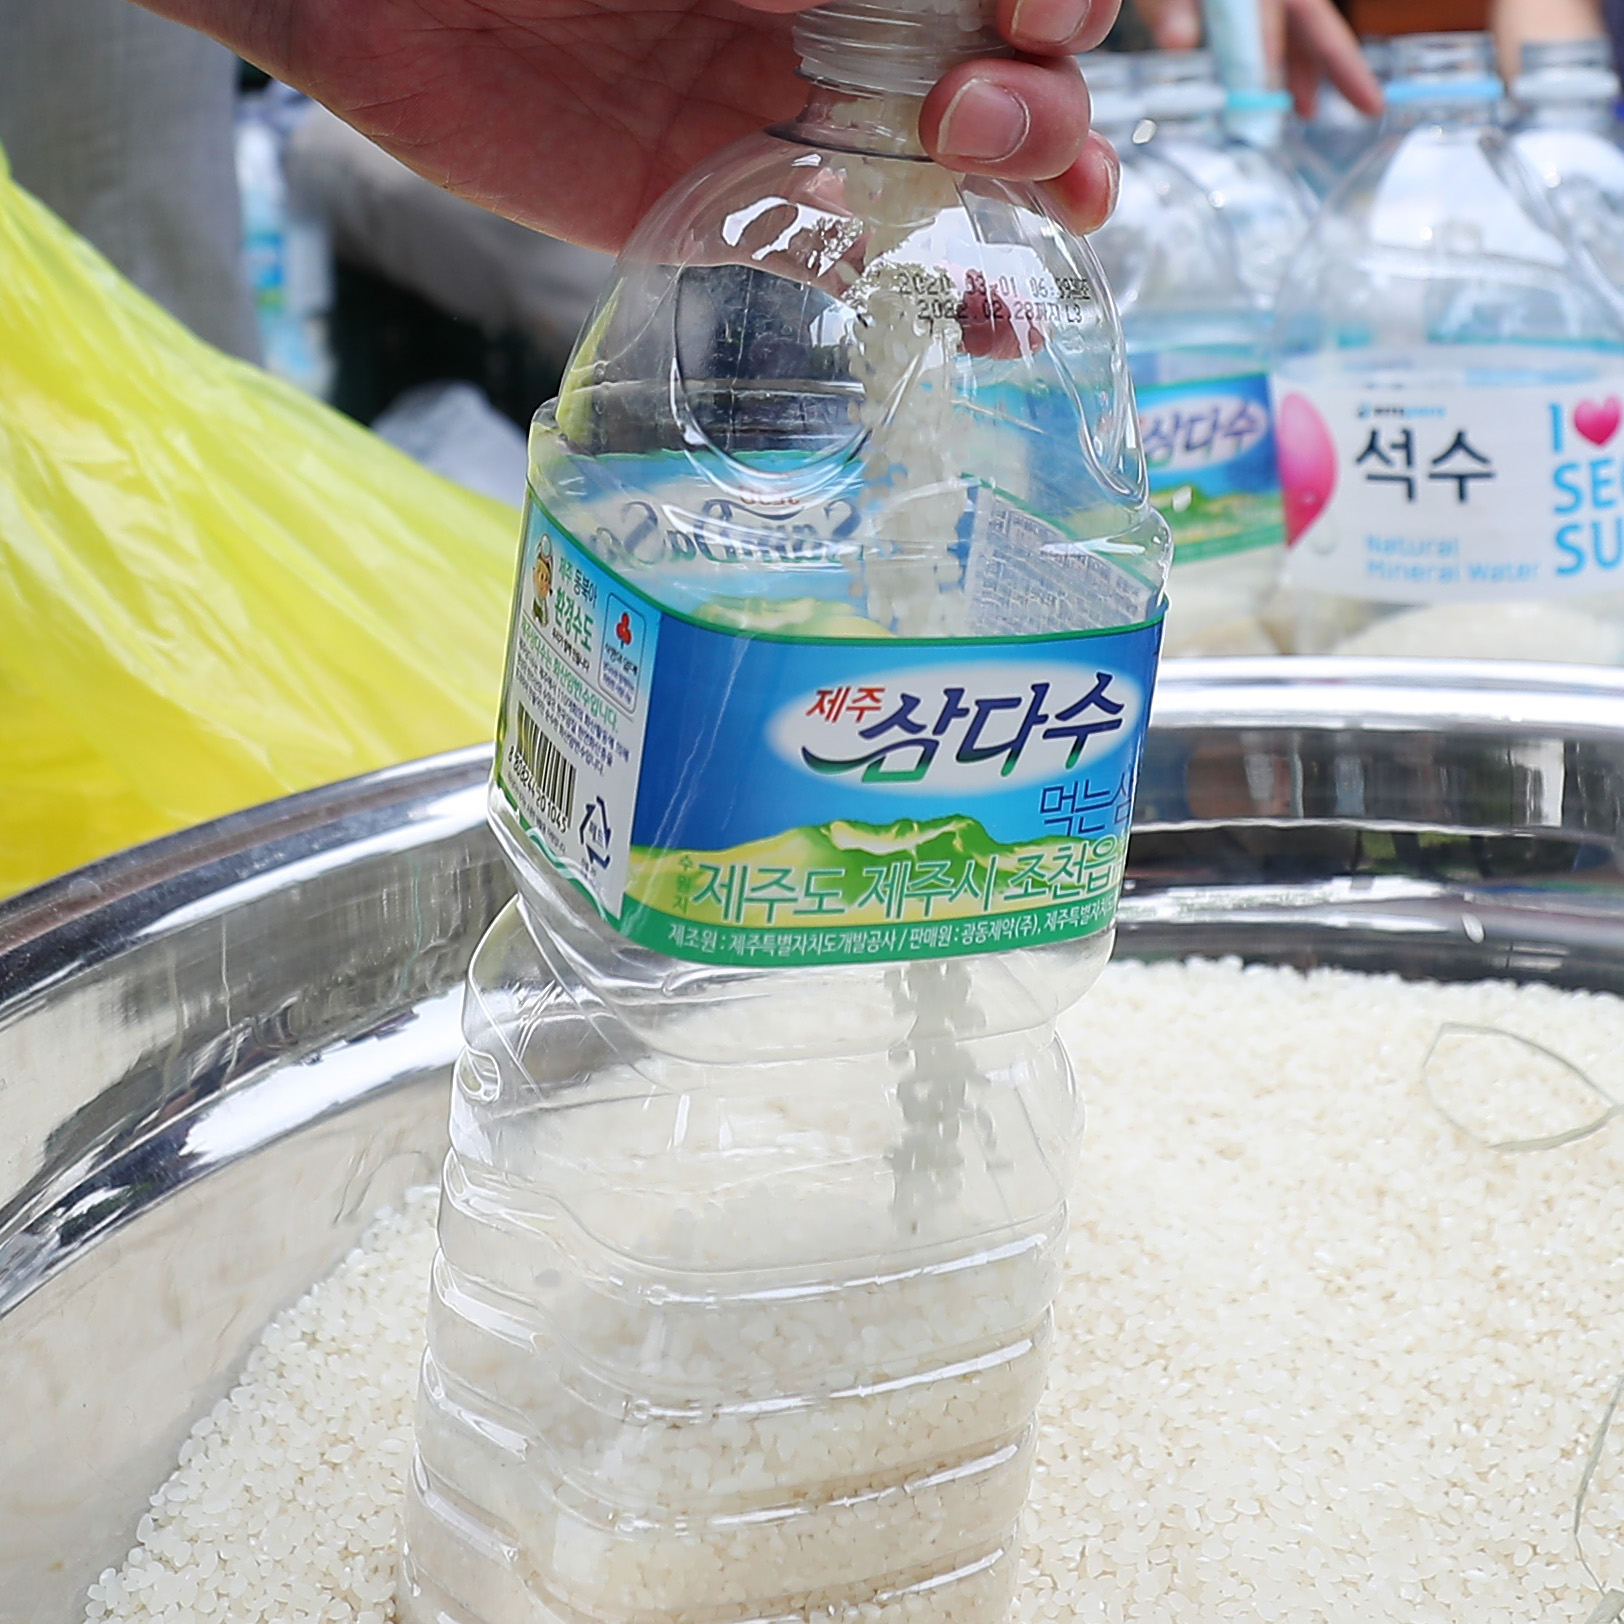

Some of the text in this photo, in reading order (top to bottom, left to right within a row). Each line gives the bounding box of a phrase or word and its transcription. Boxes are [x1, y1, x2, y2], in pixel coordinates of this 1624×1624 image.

[1356, 428, 1496, 503] 석수
[1367, 536, 1459, 556] Natural
[1555, 517, 1624, 576] SU
[1468, 562, 1540, 582] Water
[801, 672, 1125, 783] 삼다수
[806, 687, 885, 724] 제주
[691, 834, 1119, 924] 제주도 제주시 조천읍
[668, 923, 718, 954] 제조원
[730, 928, 896, 957] 제주특별자치도개발공사
[909, 925, 953, 950] 판매원
